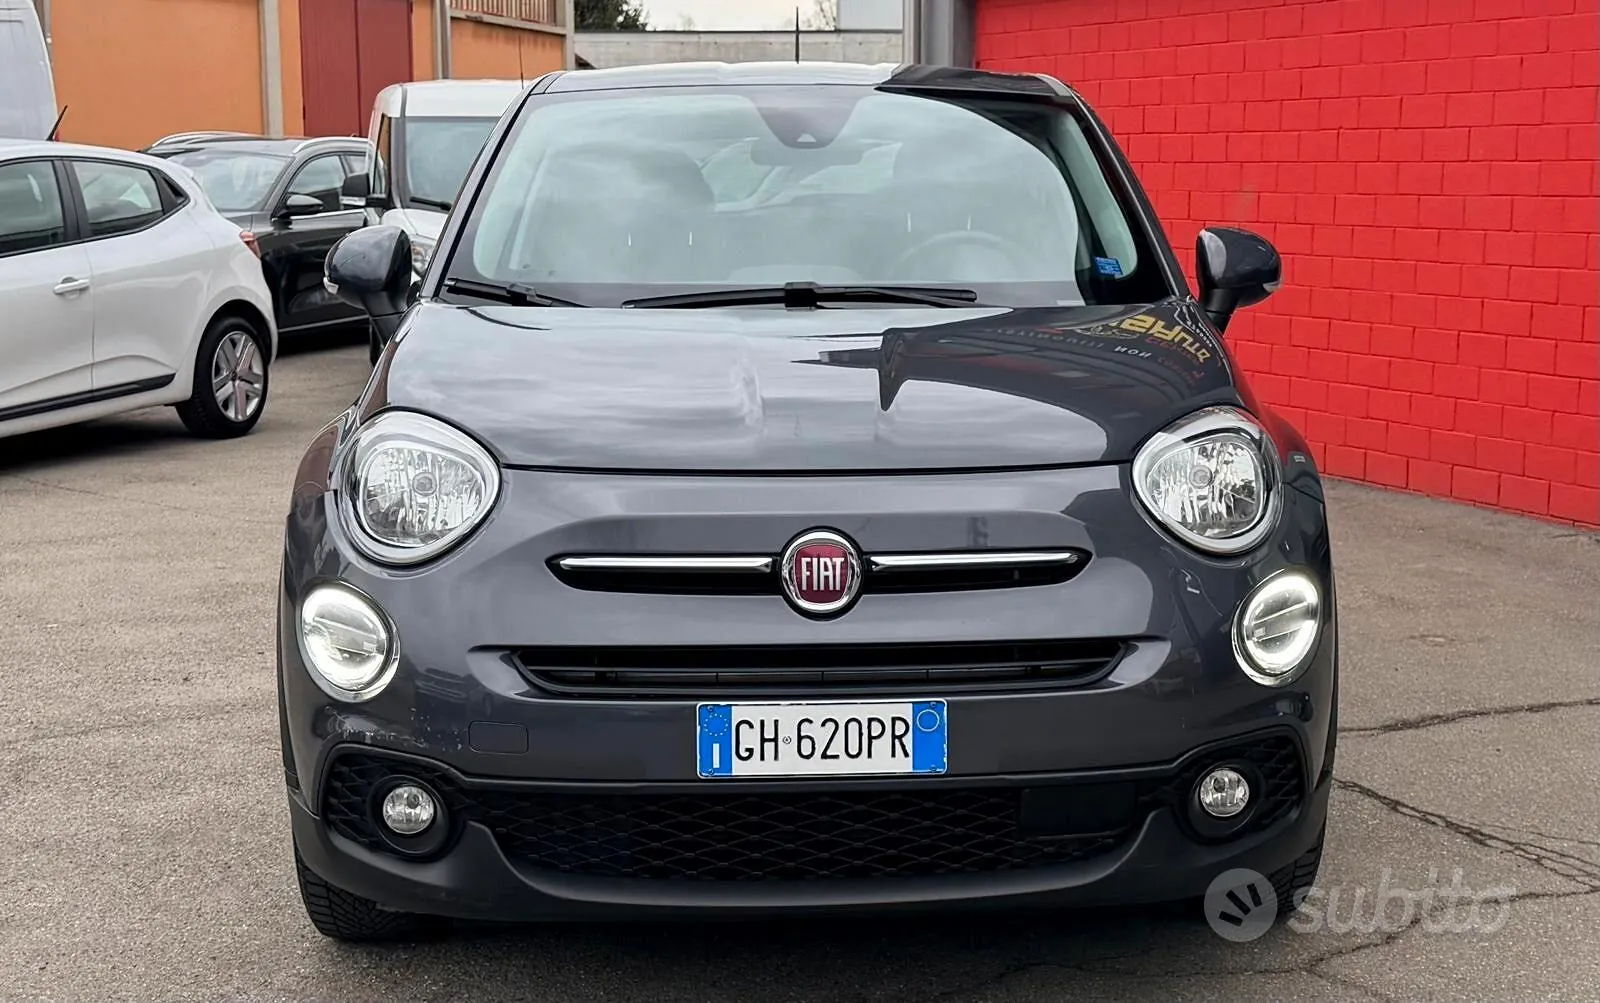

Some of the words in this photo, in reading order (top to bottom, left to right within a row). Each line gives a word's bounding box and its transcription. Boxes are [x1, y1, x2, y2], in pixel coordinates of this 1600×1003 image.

[801, 557, 845, 591] FIAT
[712, 743, 720, 769] I
[734, 719, 780, 762] GH
[796, 716, 910, 760] 620PR
